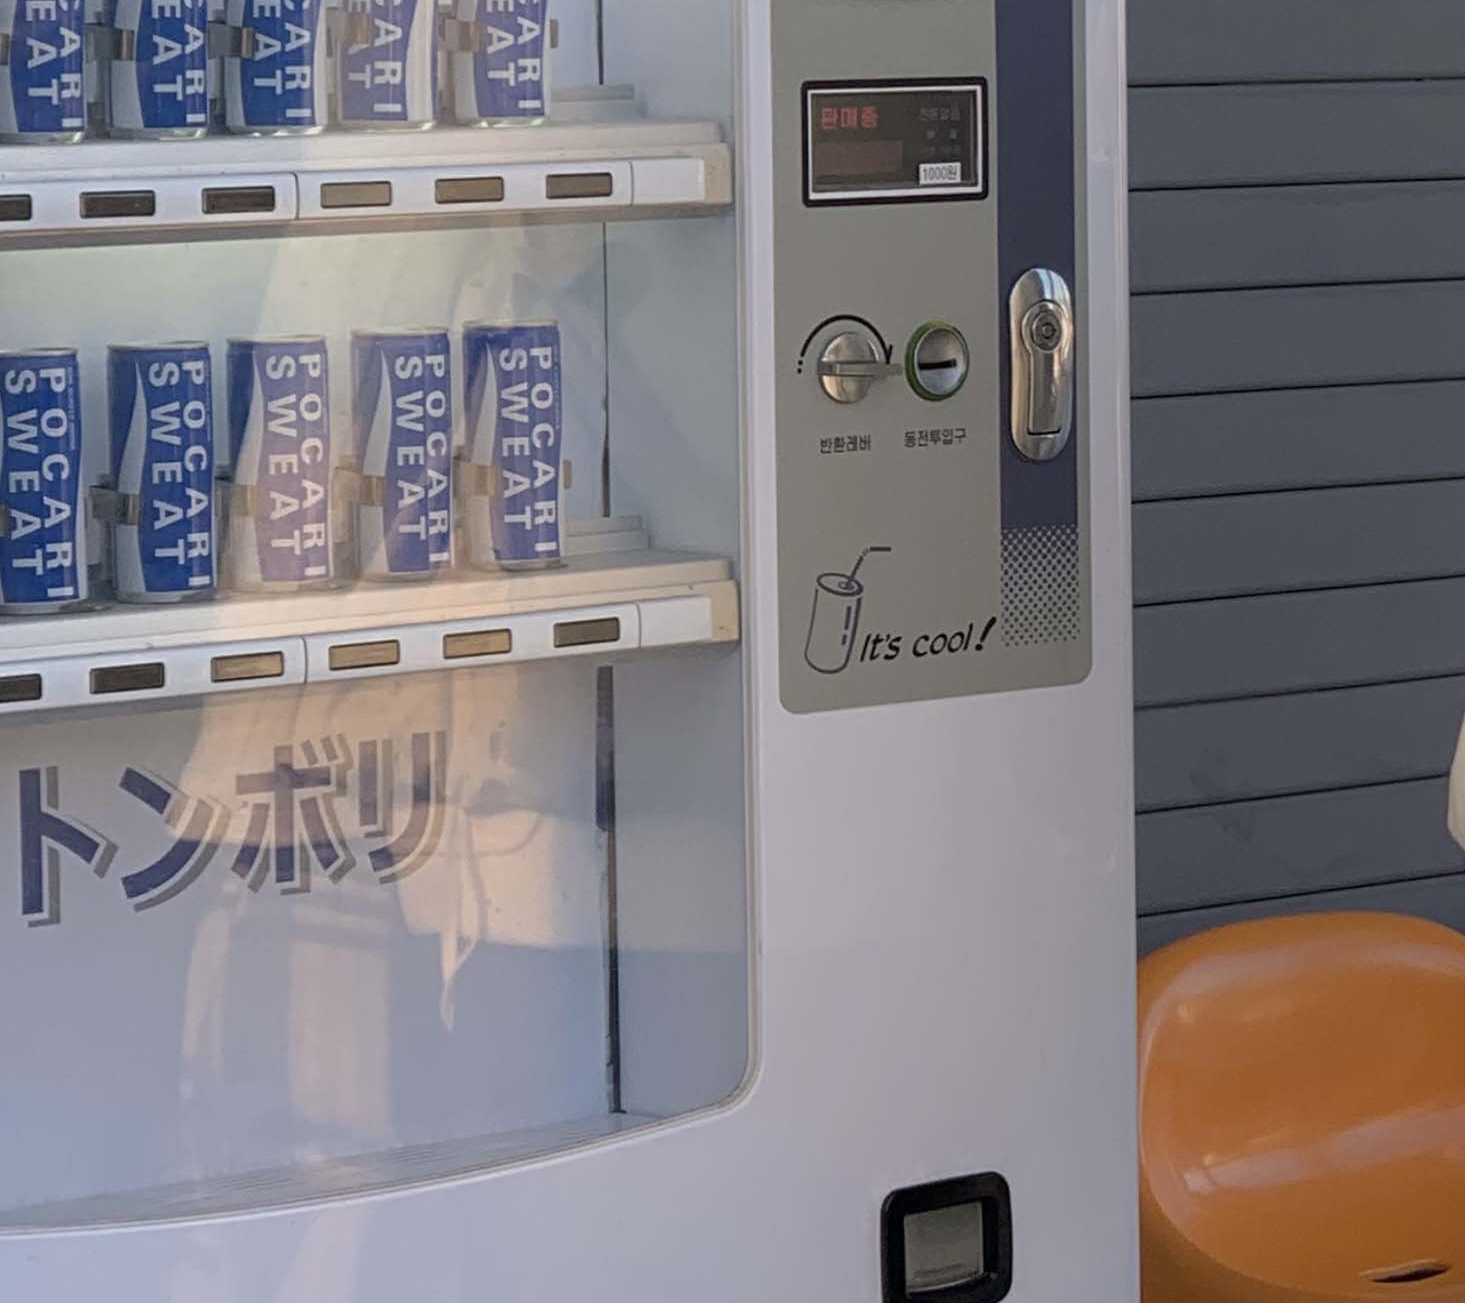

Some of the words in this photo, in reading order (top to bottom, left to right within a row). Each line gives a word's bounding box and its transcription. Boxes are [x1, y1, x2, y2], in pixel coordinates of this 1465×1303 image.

[821, 105, 878, 129] 판매중
[922, 165, 957, 181] 1000원
[4, 369, 44, 576] SWEAT
[39, 367, 74, 598] POCARI
[149, 362, 185, 565] SWEAT
[181, 360, 211, 587] POCARI
[265, 354, 301, 556] SWEAT
[299, 353, 327, 577] POCARI
[394, 355, 427, 541] SWEAT
[424, 354, 449, 563] POCARI
[499, 348, 532, 531] SWEAT
[529, 346, 557, 552] POCARI
[820, 434, 871, 454] 반환레버
[904, 427, 966, 448] 동전투입구
[860, 633, 903, 662] It's
[912, 616, 997, 658] cool!
[19, 732, 446, 927] トンボリ
